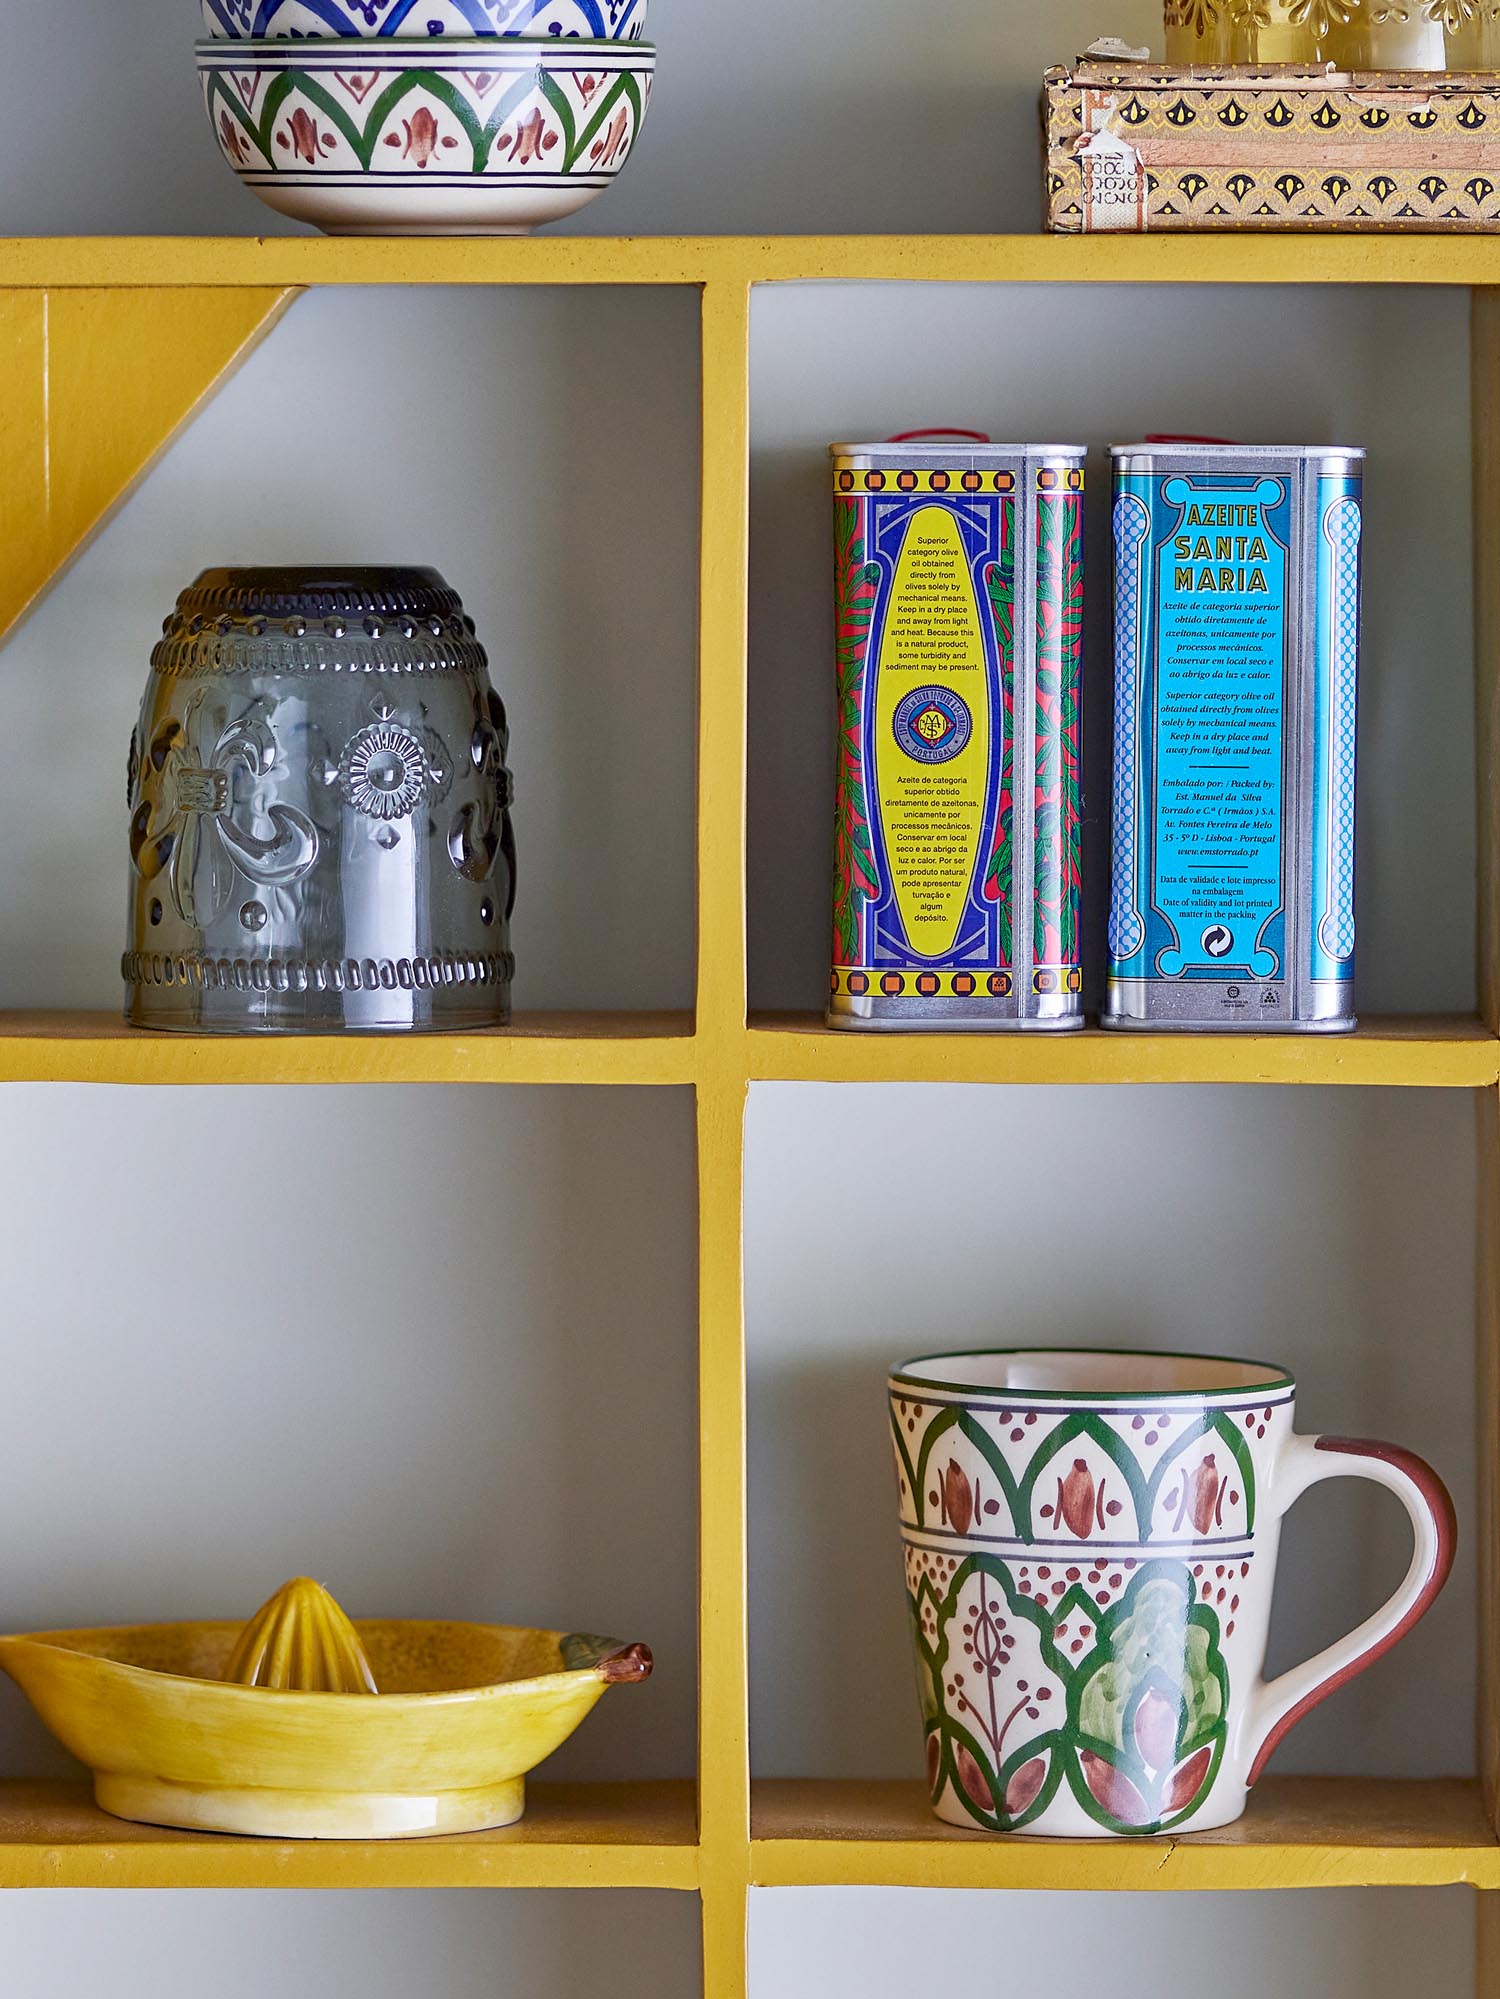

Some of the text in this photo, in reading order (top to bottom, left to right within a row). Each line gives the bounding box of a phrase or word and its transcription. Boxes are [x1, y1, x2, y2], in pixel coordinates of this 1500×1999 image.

[1187, 504, 1257, 526] AZEITE
[917, 537, 949, 545] Superior
[907, 549, 940, 557] category
[1174, 536, 1270, 562] SANTA
[910, 571, 956, 580] directly from
[1174, 567, 1269, 594] MARIA
[928, 583, 949, 592] solely
[951, 583, 960, 592] by
[898, 594, 939, 602] mechanical
[898, 606, 917, 614] Keep
[933, 606, 946, 615] dry
[947, 606, 968, 614] place
[1162, 602, 1280, 613] Azeite de categoria superior
[952, 617, 968, 626] light
[1174, 615, 1267, 624] obtido diretamente de
[1165, 630, 1276, 640] azeitonas, unicamente por
[938, 641, 968, 649] product,
[1176, 644, 1216, 653] processos
[920, 652, 951, 661] turbidity
[1226, 657, 1247, 665] local
[938, 663, 948, 671] be
[950, 664, 979, 672] present.
[1182, 670, 1210, 680] abrigo
[1212, 670, 1223, 678] da
[1225, 670, 1238, 678] luz
[1247, 671, 1270, 679] calor.
[1166, 692, 1275, 702] Superior category olive oil
[1199, 706, 1232, 715] directly
[1231, 706, 1253, 715] from
[1255, 706, 1279, 714] olives
[1161, 719, 1185, 728] solely
[1186, 718, 1196, 727] by
[1198, 719, 1247, 727] mechanical
[1170, 732, 1190, 742] Keep
[1211, 732, 1226, 742] dry
[1227, 732, 1250, 742] place
[1252, 733, 1269, 741] and
[912, 746, 953, 759] PORTUGAL
[1166, 746, 1272, 756] away from light and heat.
[921, 776, 931, 784] de
[933, 777, 967, 785] categoria
[1162, 779, 1275, 790] Embalado por: Packed by:
[904, 788, 935, 796] superior
[1192, 793, 1224, 801] Manuel
[1225, 793, 1237, 801] da
[1241, 793, 1262, 801] Silva
[885, 799, 929, 807] diretamente
[941, 800, 979, 808] azeitonas,
[1161, 806, 1194, 814] Torrado
[1178, 820, 1205, 828] Fontes
[1239, 820, 1251, 829] de
[1252, 821, 1272, 829] Melo
[897, 833, 935, 841] Conservar
[1163, 834, 1276, 844] 35 Lisboa Portugal
[933, 845, 957, 854] abrigo
[909, 868, 938, 876] produto
[902, 880, 962, 888] pode apresentar
[1160, 875, 1276, 886] Data de validade lote impresso
[912, 891, 944, 900] turvação
[1202, 887, 1243, 897] embalagem
[920, 903, 943, 911] algum
[1163, 898, 1272, 909] Date of validity and lot printed
[914, 914, 948, 923] depósito.
[1205, 910, 1212, 918] in
[1214, 910, 1226, 918] the
[1228, 910, 1256, 920] packing
